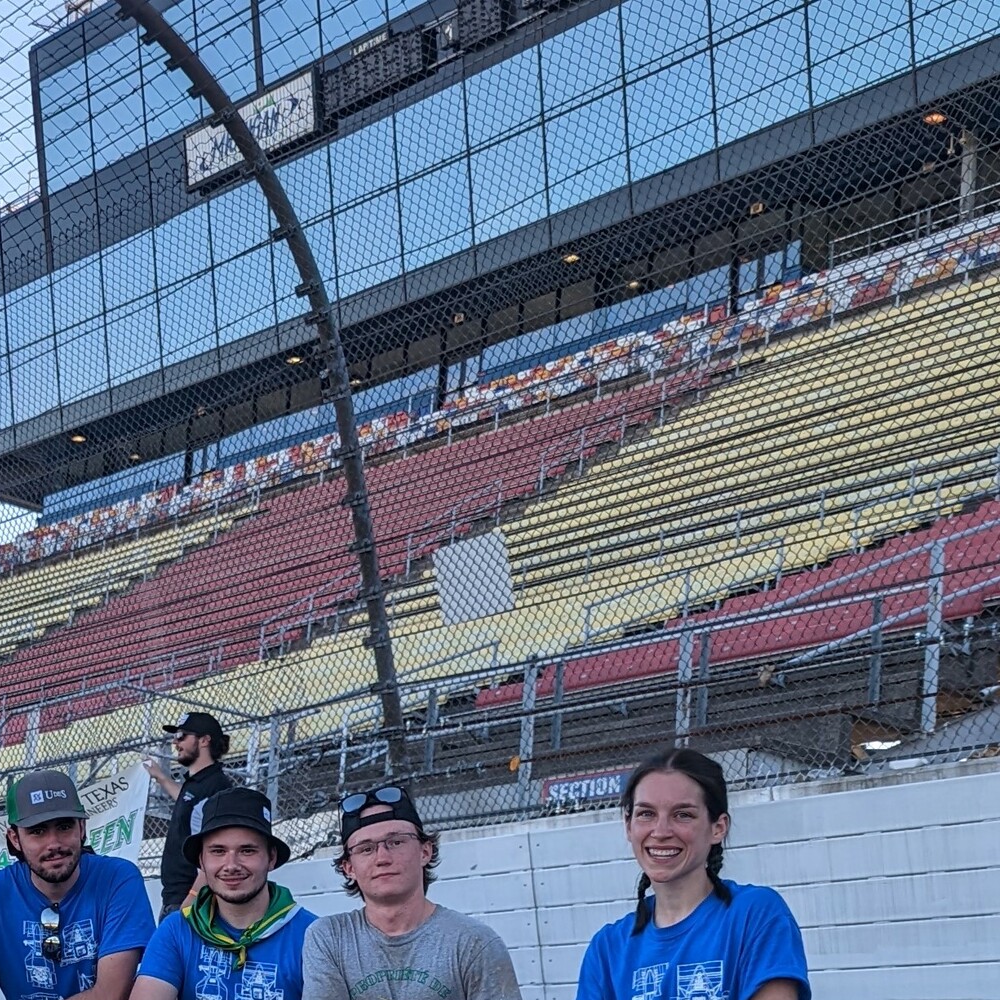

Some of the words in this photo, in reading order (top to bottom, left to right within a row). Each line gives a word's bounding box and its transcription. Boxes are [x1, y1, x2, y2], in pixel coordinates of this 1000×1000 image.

[81, 777, 129, 806] TEXAS
[549, 775, 621, 801] SECTION
[86, 798, 118, 817] INEERS
